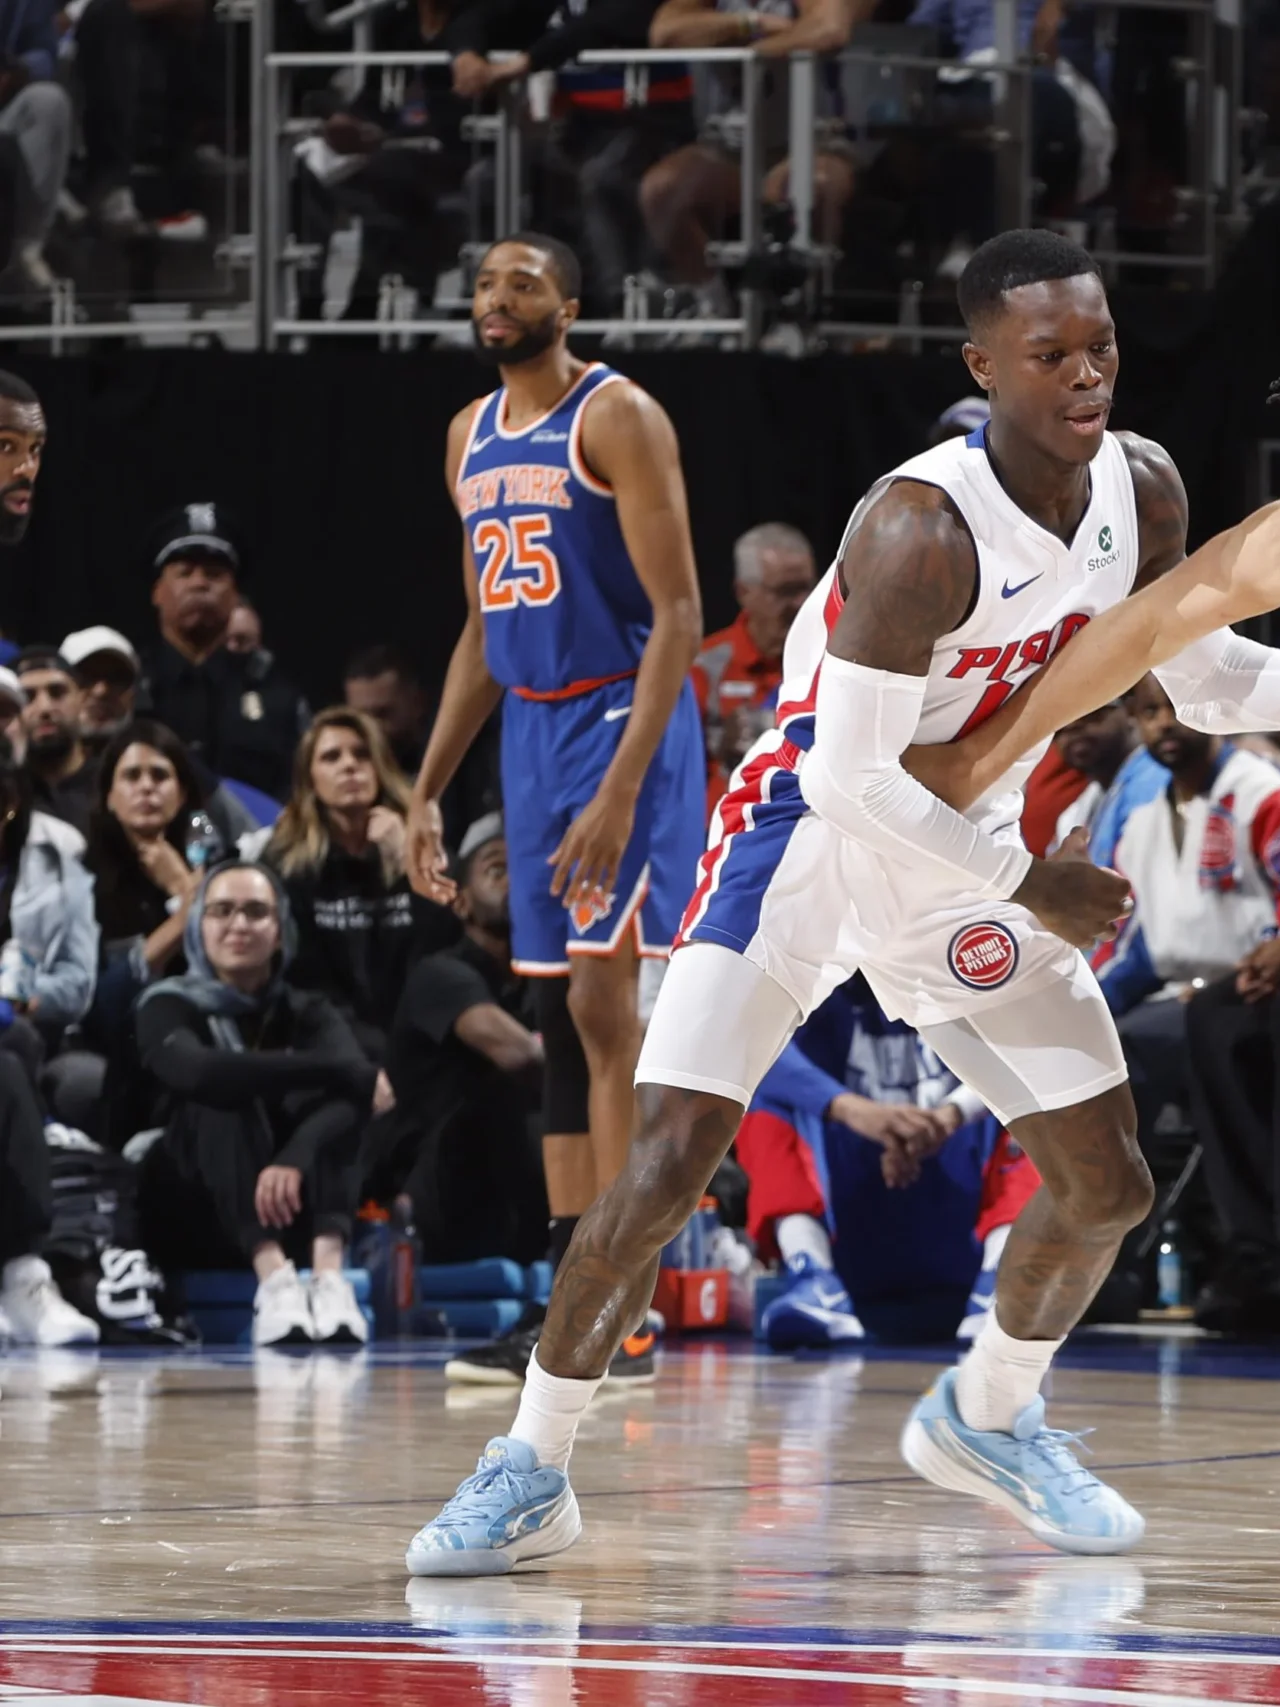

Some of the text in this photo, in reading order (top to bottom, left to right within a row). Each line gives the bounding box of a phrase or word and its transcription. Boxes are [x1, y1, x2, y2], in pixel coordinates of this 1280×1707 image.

[502, 464, 573, 510] YORK
[473, 513, 562, 613] 25
[960, 936, 1002, 963] DETROIT
[964, 946, 1008, 974] PISTONS
